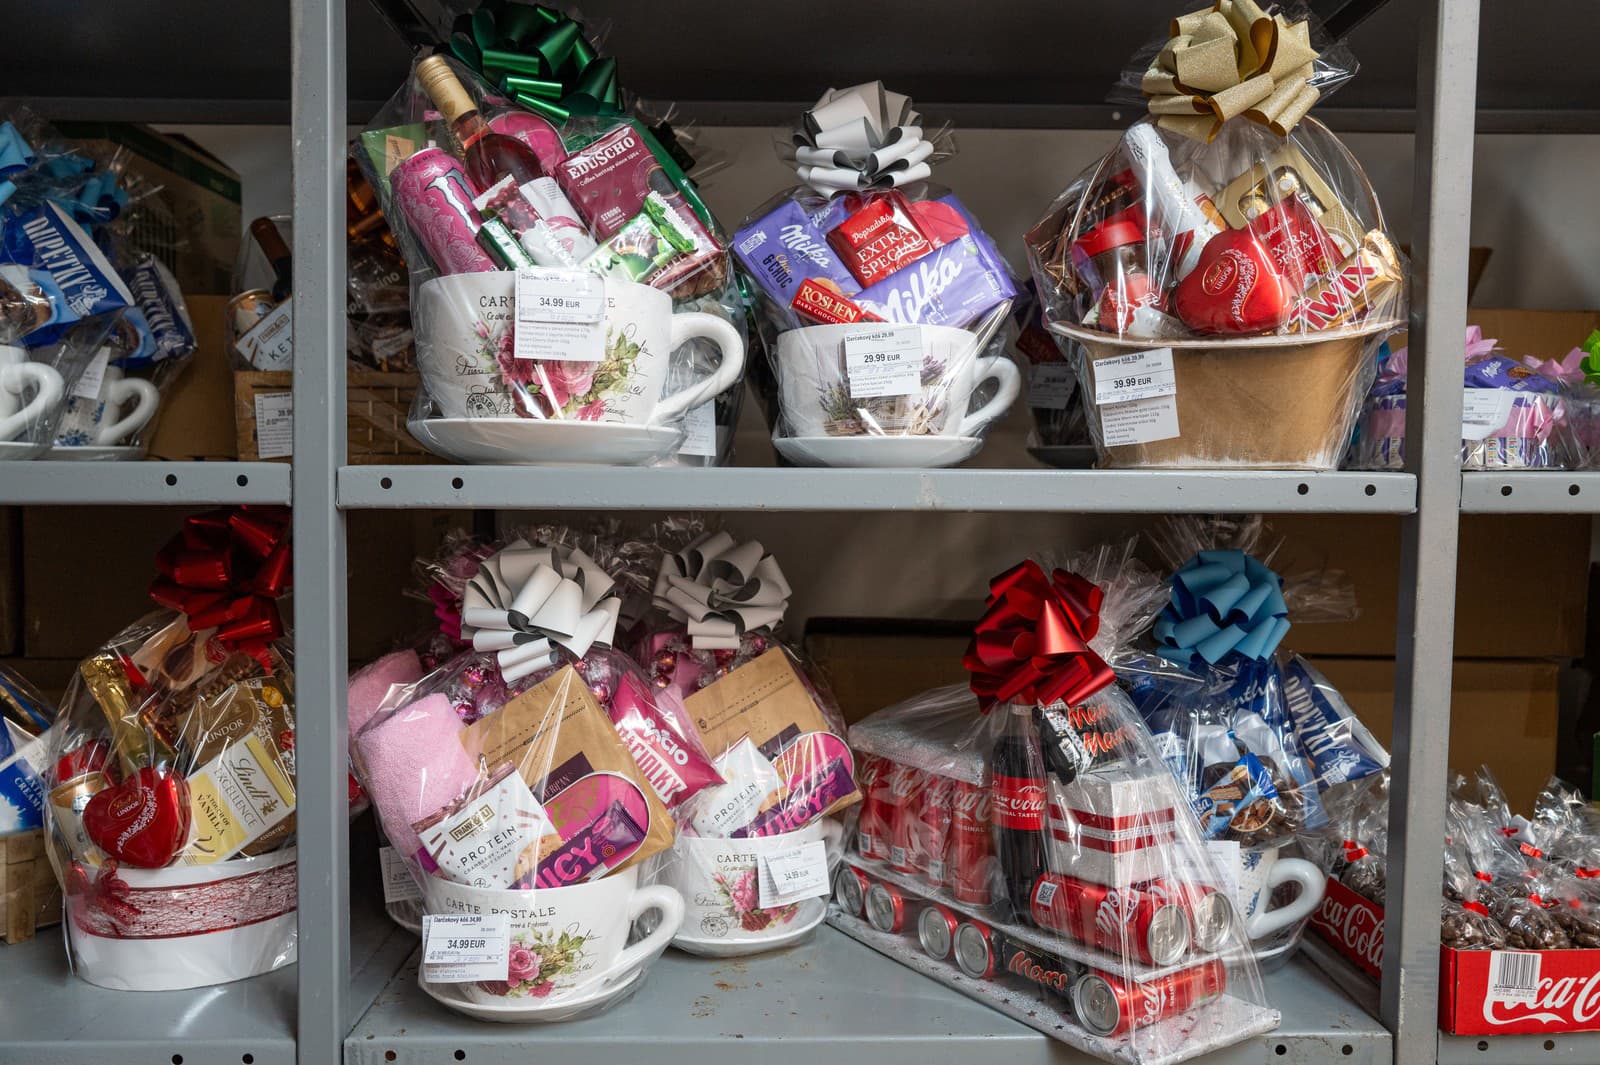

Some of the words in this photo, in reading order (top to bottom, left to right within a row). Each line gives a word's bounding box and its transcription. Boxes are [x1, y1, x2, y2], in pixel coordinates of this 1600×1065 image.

[568, 136, 636, 180] EDUSCHO
[812, 206, 832, 229] ilka
[779, 224, 831, 269] Milka
[856, 225, 911, 263] EXTRA
[1270, 230, 1310, 257] XTRA
[767, 260, 793, 289] CHOC
[775, 253, 793, 274] Choc
[1214, 266, 1233, 290] LINDOR
[479, 296, 516, 308] CART
[539, 297, 564, 307] 34.99
[801, 285, 858, 322] ROSHEN
[872, 257, 963, 325] Milka
[796, 299, 812, 311] DARK
[864, 353, 886, 363] 29.99
[1113, 377, 1136, 389] 39.99
[1137, 377, 1152, 386] EUR
[205, 718, 246, 744] LINDOR
[26, 774, 45, 799] EXTR
[230, 758, 273, 801] Lindt
[116, 800, 140, 818] LINDOR
[213, 766, 258, 828] EXCELLENCE
[713, 782, 758, 823] PROTEIN
[196, 794, 226, 836] VANILLA
[453, 820, 475, 839] FRANK
[460, 825, 517, 867] PROTEIN
[716, 853, 758, 864] CARTE
[446, 897, 482, 915] CARTE
[447, 939, 470, 950] 34.99
[469, 939, 486, 949] EUR
[1008, 950, 1068, 991] Mars
